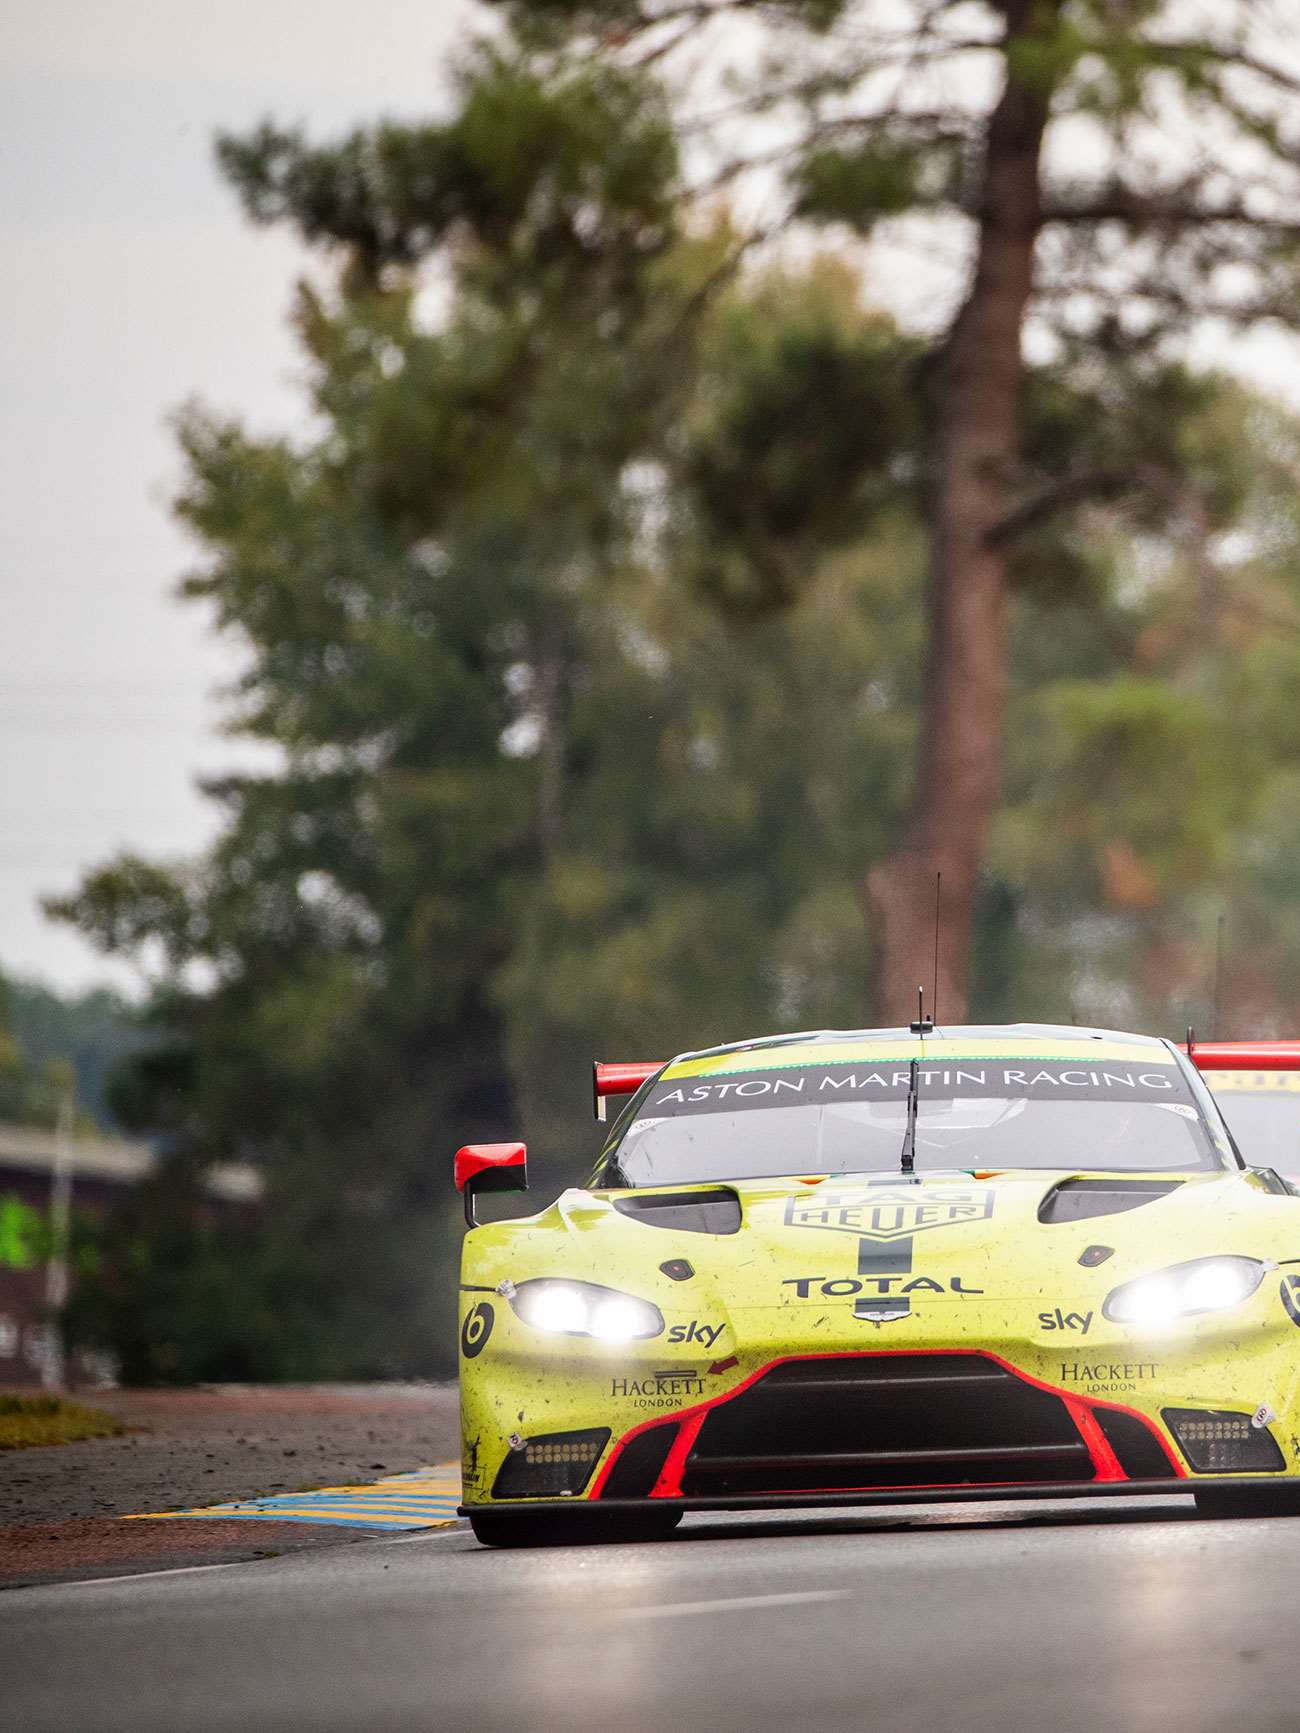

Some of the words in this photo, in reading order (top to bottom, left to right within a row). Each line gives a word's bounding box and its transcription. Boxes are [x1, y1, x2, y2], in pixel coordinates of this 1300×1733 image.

[656, 1077, 805, 1105] ASTON
[818, 1069, 986, 1091] MARTIN
[1003, 1070, 1173, 1088] RACING
[801, 1205, 978, 1232] HEUER
[782, 1276, 984, 1298] TOTAL
[1038, 1307, 1094, 1335] sky
[667, 1320, 726, 1349] sky
[1060, 1362, 1159, 1381] HACKETT
[611, 1378, 707, 1397] HACKETT
[1086, 1383, 1137, 1393] LONDON
[633, 1398, 682, 1408] LONDON
